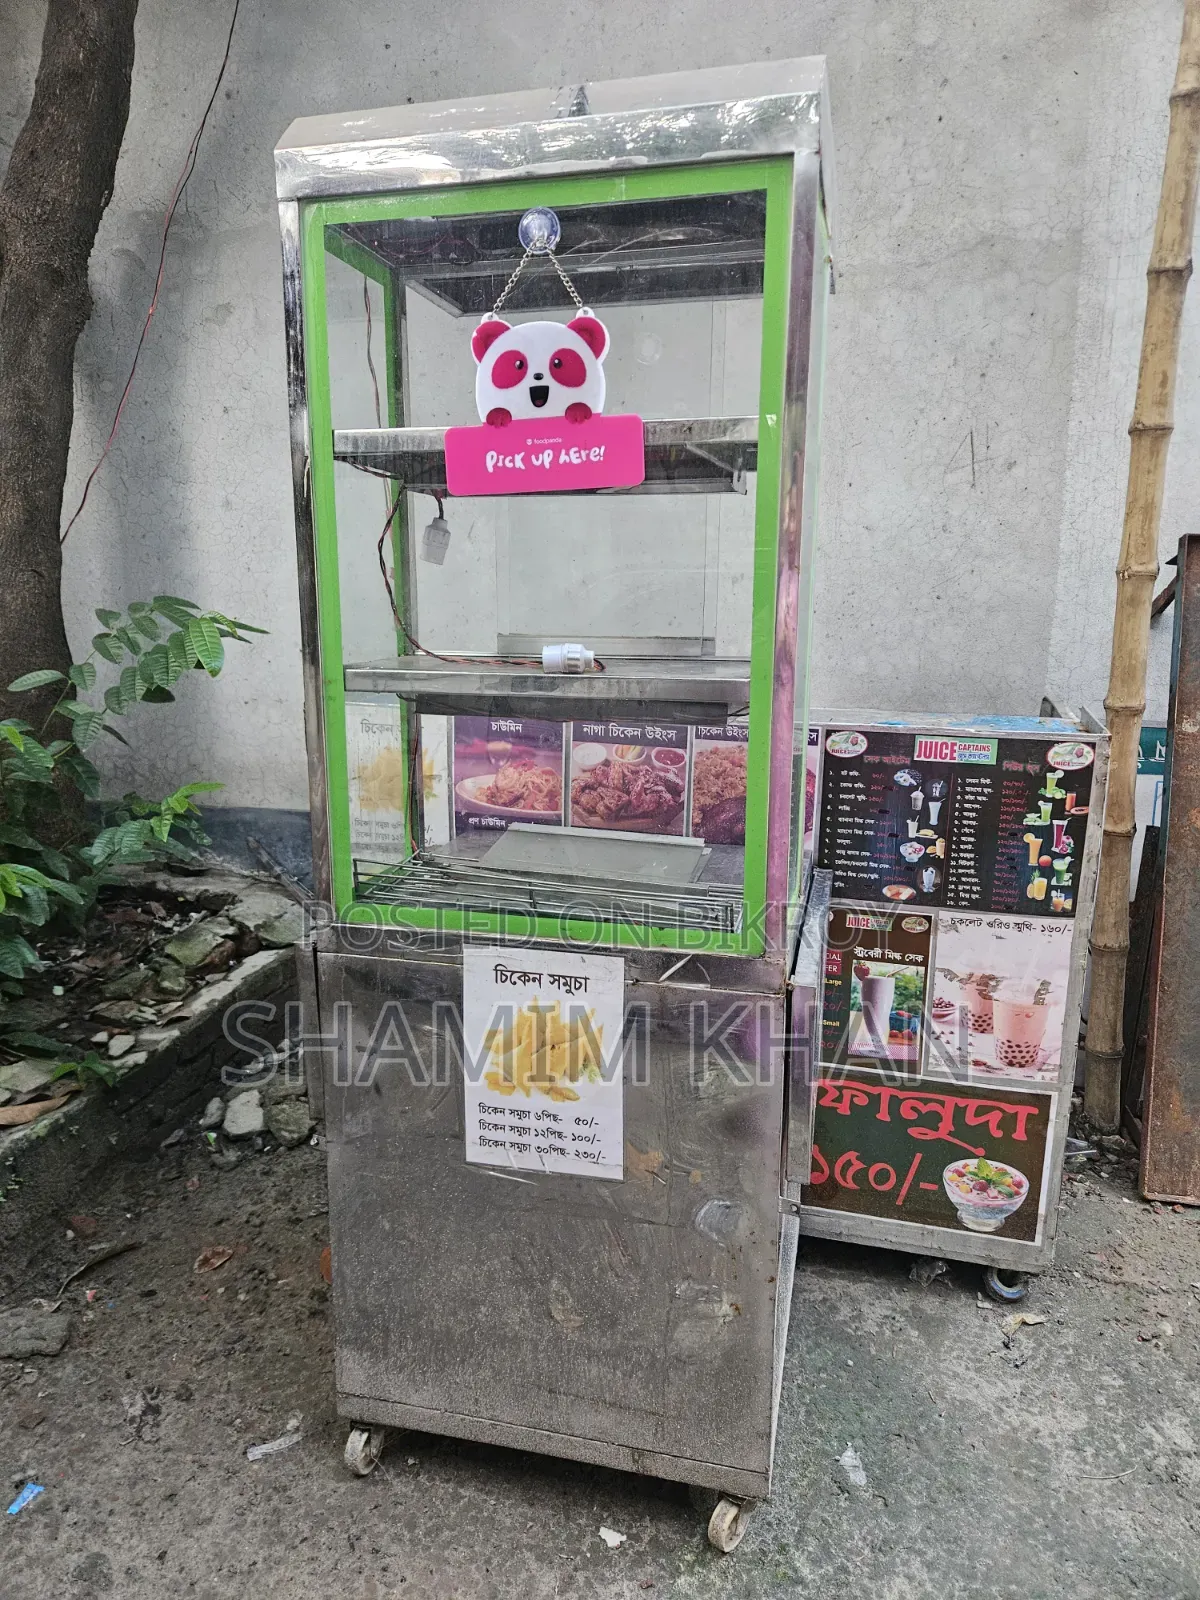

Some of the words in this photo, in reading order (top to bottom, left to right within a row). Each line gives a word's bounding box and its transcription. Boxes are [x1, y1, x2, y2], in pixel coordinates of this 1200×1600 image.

[533, 437, 562, 445] foodpanda
[360, 719, 393, 734] চিকেন
[491, 720, 522, 733] চাউমিন
[583, 723, 605, 737] নাগা
[609, 722, 641, 739] চিকেন
[645, 725, 677, 742] উইংস
[698, 726, 724, 736] চিকেন
[916, 740, 957, 761] JUICE
[958, 744, 991, 752] CAPTAINS
[481, 816, 506, 827] চাউমিন
[847, 917, 870, 928] JUICE
[950, 917, 984, 928] চকলেট
[987, 918, 1011, 929] ওরিও
[1040, 924, 1072, 935] ১৬০/-
[826, 953, 841, 961] CIAL
[905, 953, 925, 963] সেক
[493, 963, 544, 988] চিকেন
[548, 974, 590, 996] সমুচা
[478, 1102, 506, 1117] চিকেন
[508, 1108, 531, 1121] সমুচা
[534, 1109, 563, 1123] ৬পিছ-
[574, 1116, 600, 1128] ৫০/-
[817, 1079, 1039, 1156] ফালুদা
[478, 1119, 506, 1134] চিকেন
[508, 1124, 531, 1137] সমুচা
[534, 1127, 568, 1141] ১২পিছ-
[571, 1132, 602, 1145] ১০০/-
[479, 1136, 506, 1150] চিকেন
[509, 1141, 531, 1154] সমুচা
[535, 1143, 571, 1158] ৩০পিছ-
[574, 1149, 607, 1162] ২৩০/-
[810, 1144, 939, 1206] ১৫০/-
